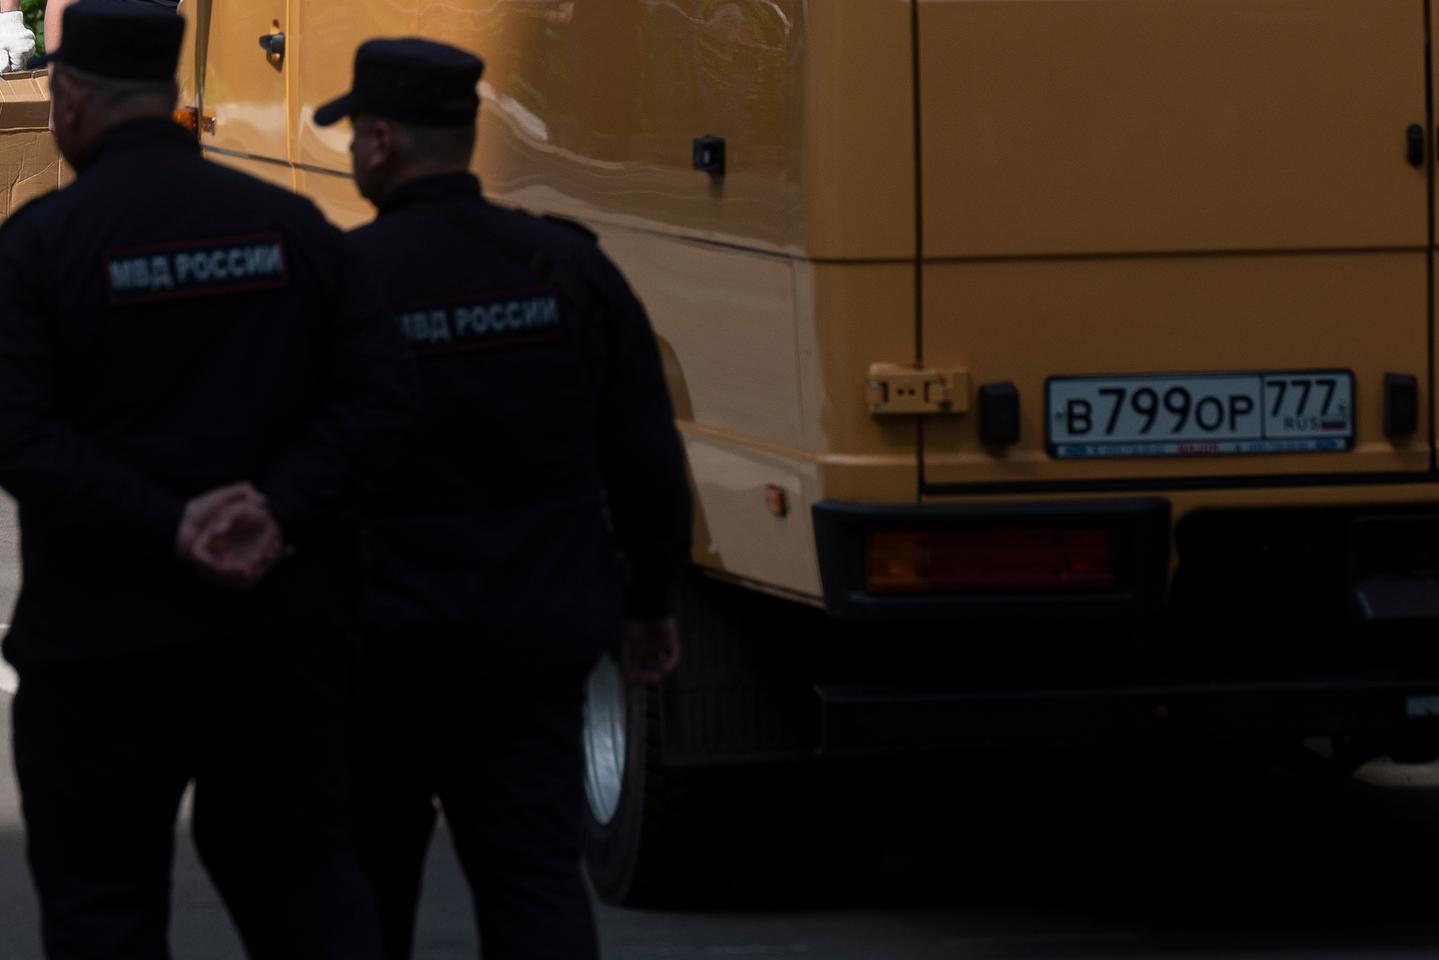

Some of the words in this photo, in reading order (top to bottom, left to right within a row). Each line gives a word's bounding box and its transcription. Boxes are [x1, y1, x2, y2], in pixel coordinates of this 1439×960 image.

[109, 255, 174, 290] МВД
[175, 244, 283, 283] РОССИИ
[458, 296, 558, 336] РОССИИ
[1065, 386, 1255, 436] В799ОР
[1266, 378, 1338, 418] 777
[1283, 414, 1320, 431] RUS
